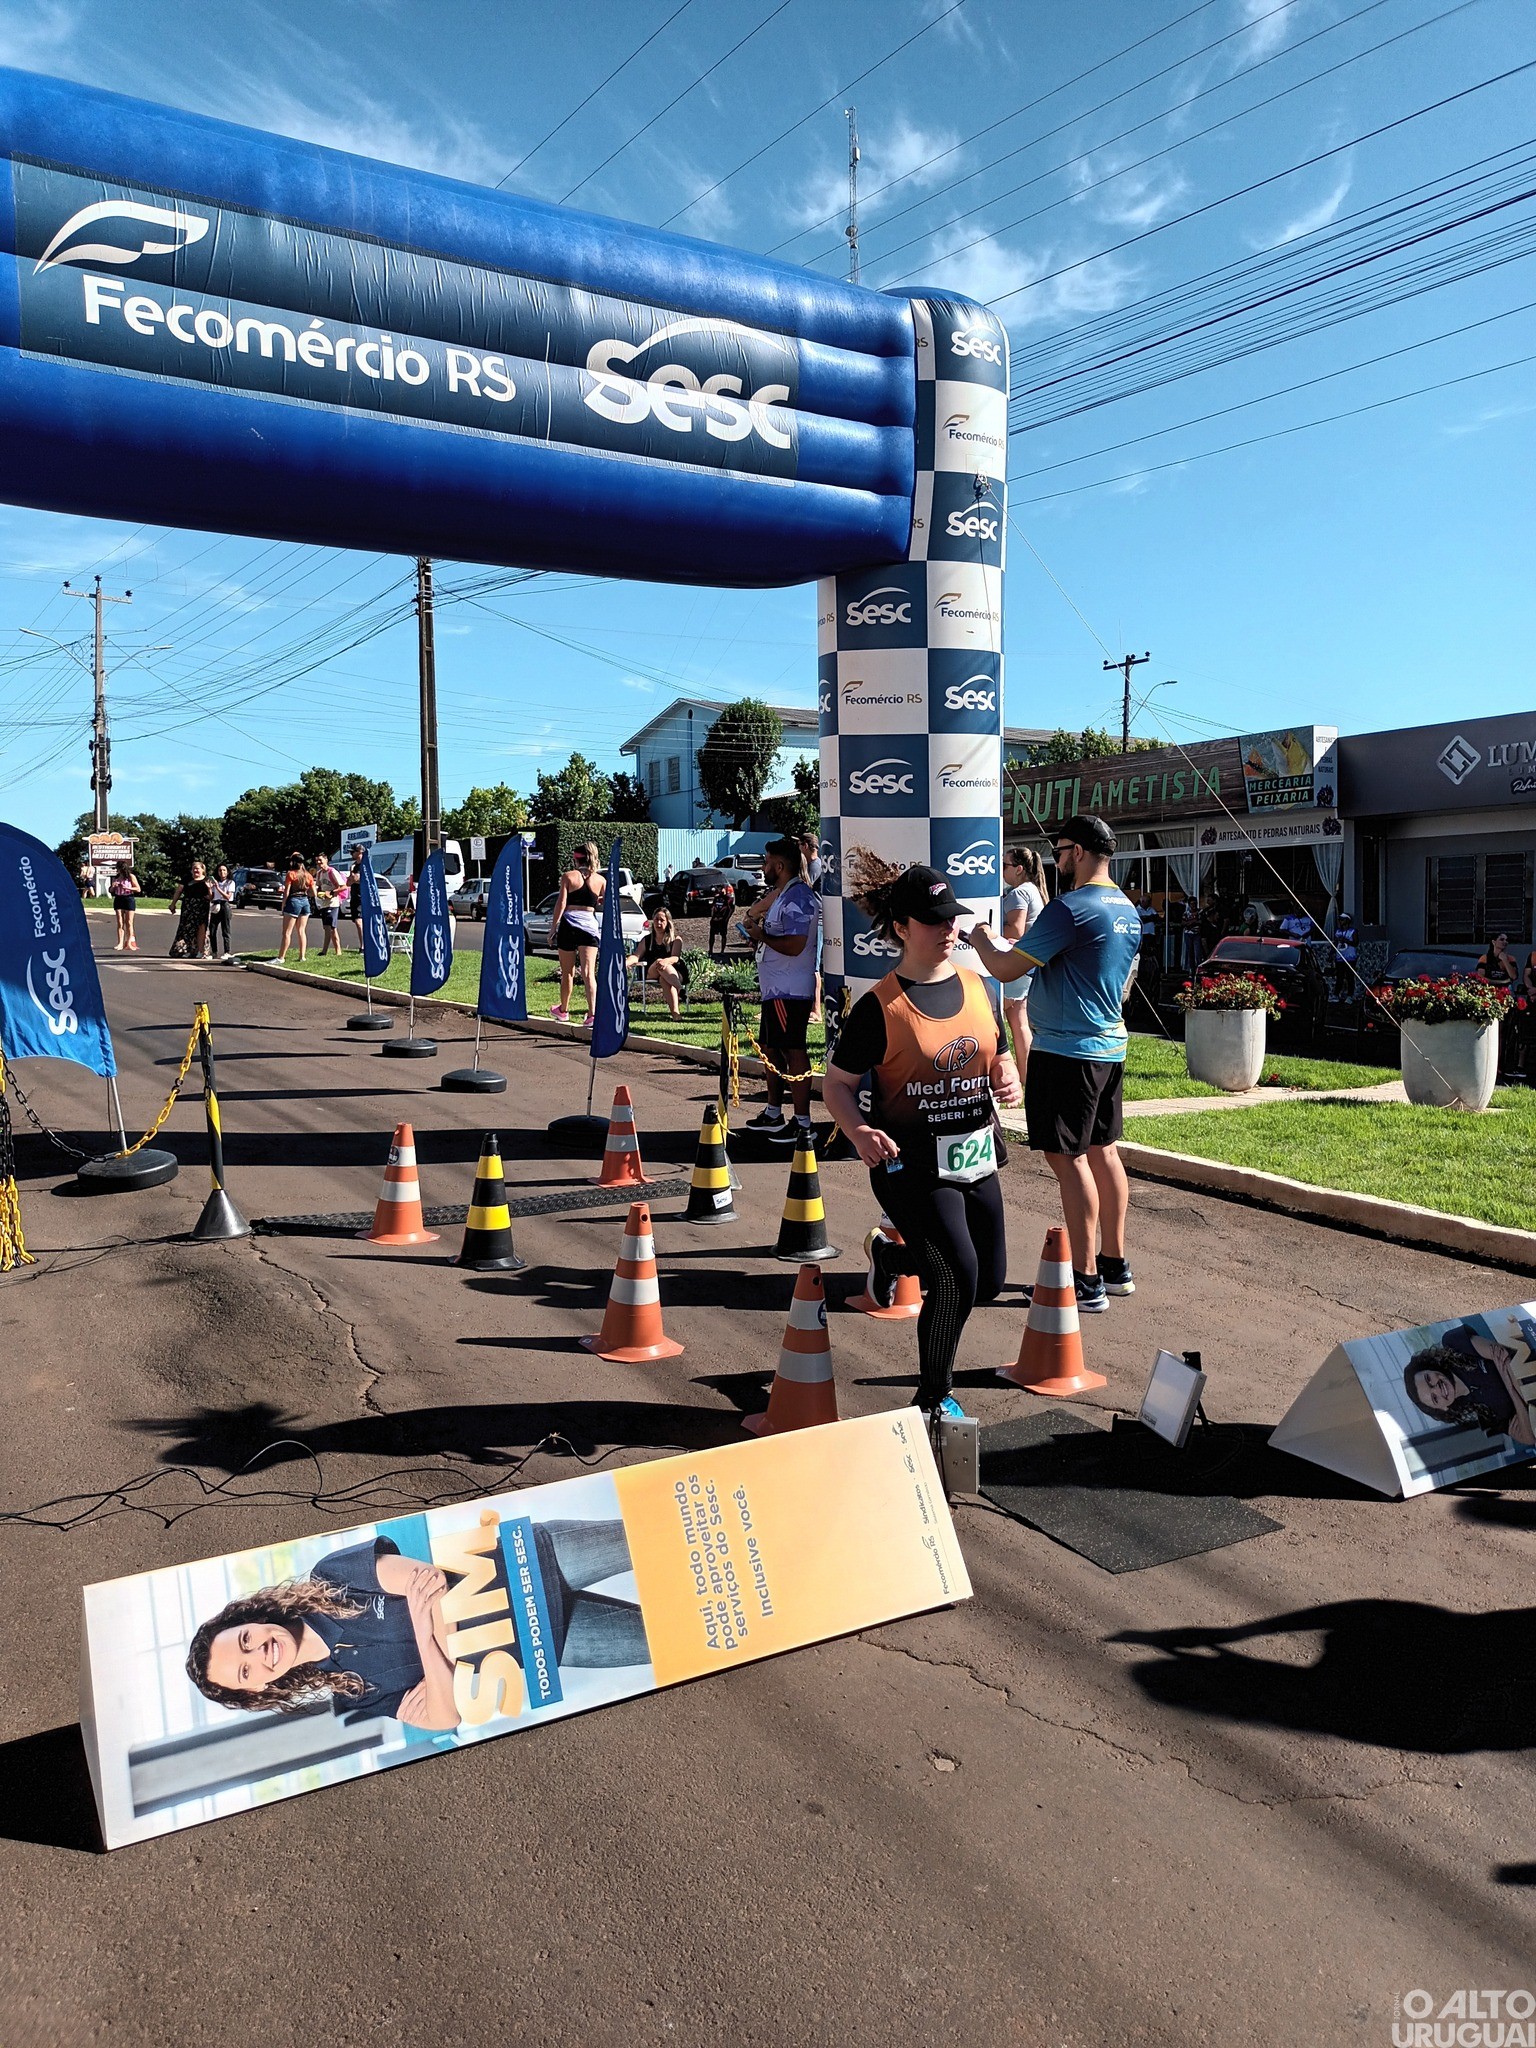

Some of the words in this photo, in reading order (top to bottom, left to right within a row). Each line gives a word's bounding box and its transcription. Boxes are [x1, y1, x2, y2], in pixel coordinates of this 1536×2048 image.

[82, 274, 430, 386] Fecomércio
[445, 347, 517, 403] RS
[950, 330, 1002, 367] Sesc
[583, 336, 791, 450] Sesc
[949, 428, 998, 447] Fecomércio
[945, 510, 998, 542] Sesc
[845, 601, 912, 626] Sesc
[941, 606, 992, 621] Fecomércio
[845, 693, 904, 705] Fecomércio
[906, 693, 923, 704] RS
[944, 685, 996, 712] Sesc
[848, 770, 914, 795] Sesc
[942, 777, 992, 788] Fecomércio
[1089, 766, 1221, 809] AMETISTA
[1249, 775, 1312, 792] MERCEARIA
[1256, 790, 1309, 805] PEIXARIA
[1258, 829, 1262, 838] E
[1263, 827, 1288, 839] PEDRAS
[1288, 824, 1321, 836] NATURAIS
[945, 853, 996, 876] Sesc
[19, 856, 46, 938] Fecomércio
[427, 864, 437, 916] Fecomércio
[504, 865, 514, 925] Fecomércio
[44, 890, 61, 934] Senac
[375, 914, 388, 962] Sesc
[431, 923, 445, 981] Sesc
[833, 937, 842, 947] RS
[852, 933, 901, 957] Ses
[504, 935, 520, 1002] Sesc
[42, 947, 78, 1036] Sesc
[614, 953, 627, 1037] Sesc
[906, 1080, 945, 1096] Med
[950, 1076, 990, 1093] Form
[918, 1092, 989, 1110] Academia
[927, 1111, 965, 1123] SEBERI
[972, 1107, 983, 1117] RS
[947, 1134, 993, 1172] 624
[688, 1474, 701, 1495] os
[705, 1479, 722, 1526] Sesc.
[914, 1484, 930, 1525] Sindicatos
[674, 1480, 697, 1545] mundo
[732, 1484, 753, 1532] você.
[511, 1525, 530, 1564] SESC.
[693, 1501, 723, 1594] aproveitar
[715, 1531, 729, 1555] do
[927, 1535, 938, 1548] RS
[518, 1565, 533, 1595] SER
[689, 1550, 708, 1596] todo
[747, 1536, 774, 1617] Inclusive
[932, 1548, 951, 1596] Fecomércio
[722, 1560, 749, 1637] serviços
[525, 1596, 545, 1647] PODEM
[699, 1599, 721, 1650] Aqui,
[715, 1600, 739, 1650] pode
[534, 1647, 552, 1700] TODOS
